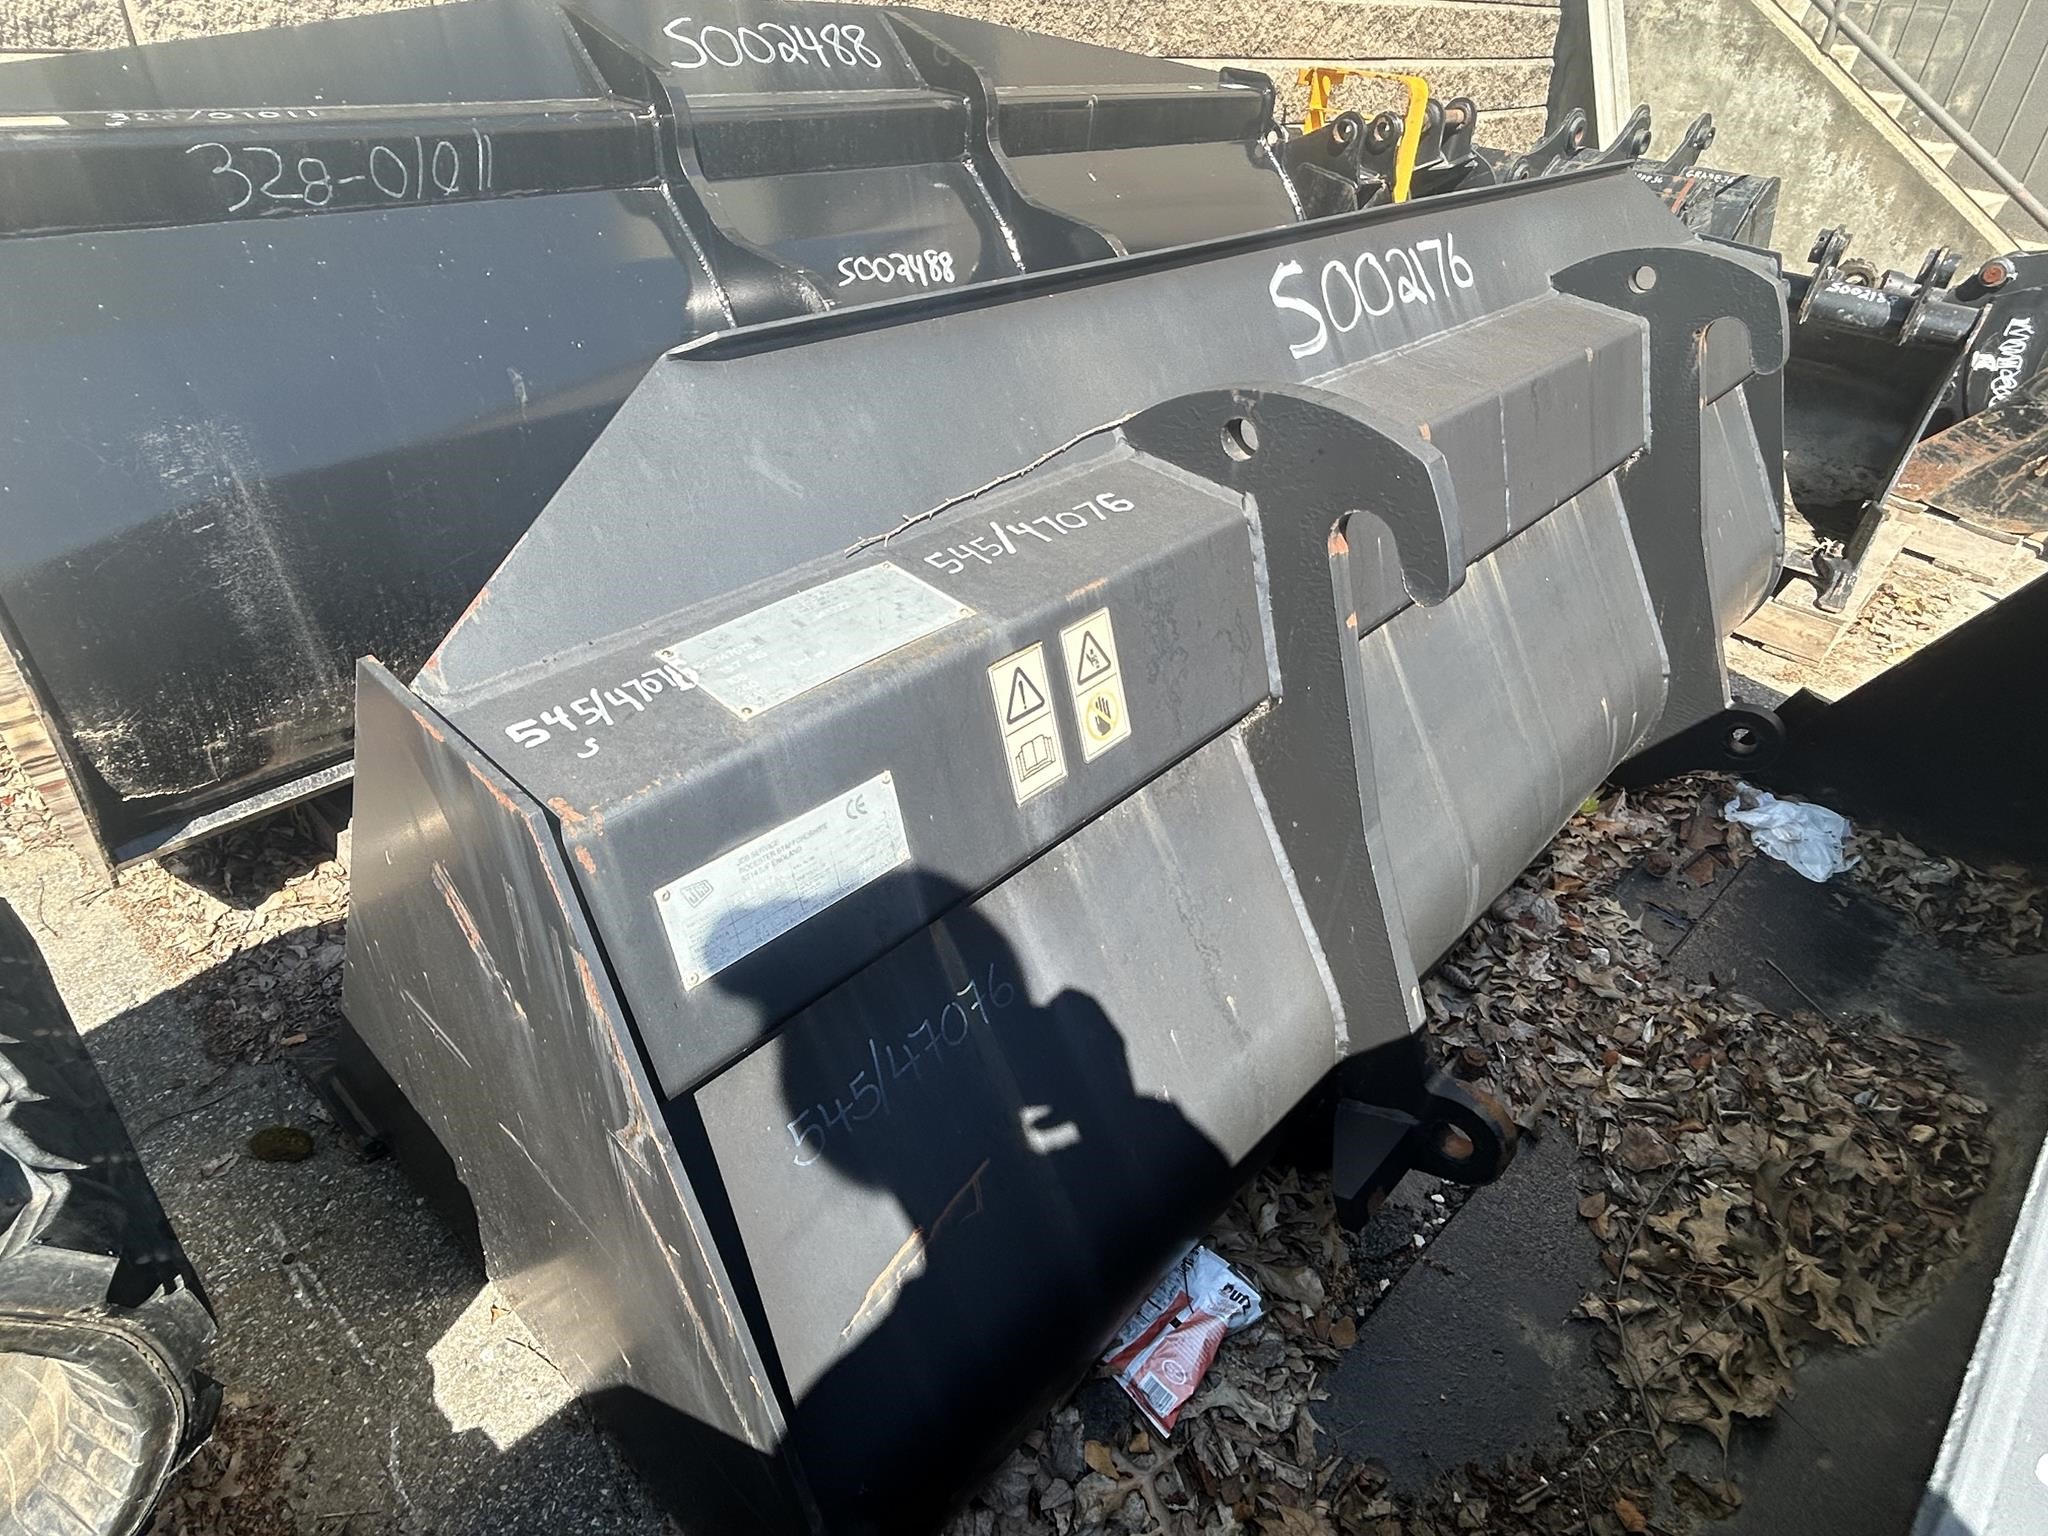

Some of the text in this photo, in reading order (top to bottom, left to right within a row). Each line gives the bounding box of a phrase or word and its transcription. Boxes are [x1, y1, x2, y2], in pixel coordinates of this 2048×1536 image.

[185, 127, 494, 212] 328-01011
[924, 492, 1135, 575] 545/47076
[786, 963, 1014, 1166] 545/47076
